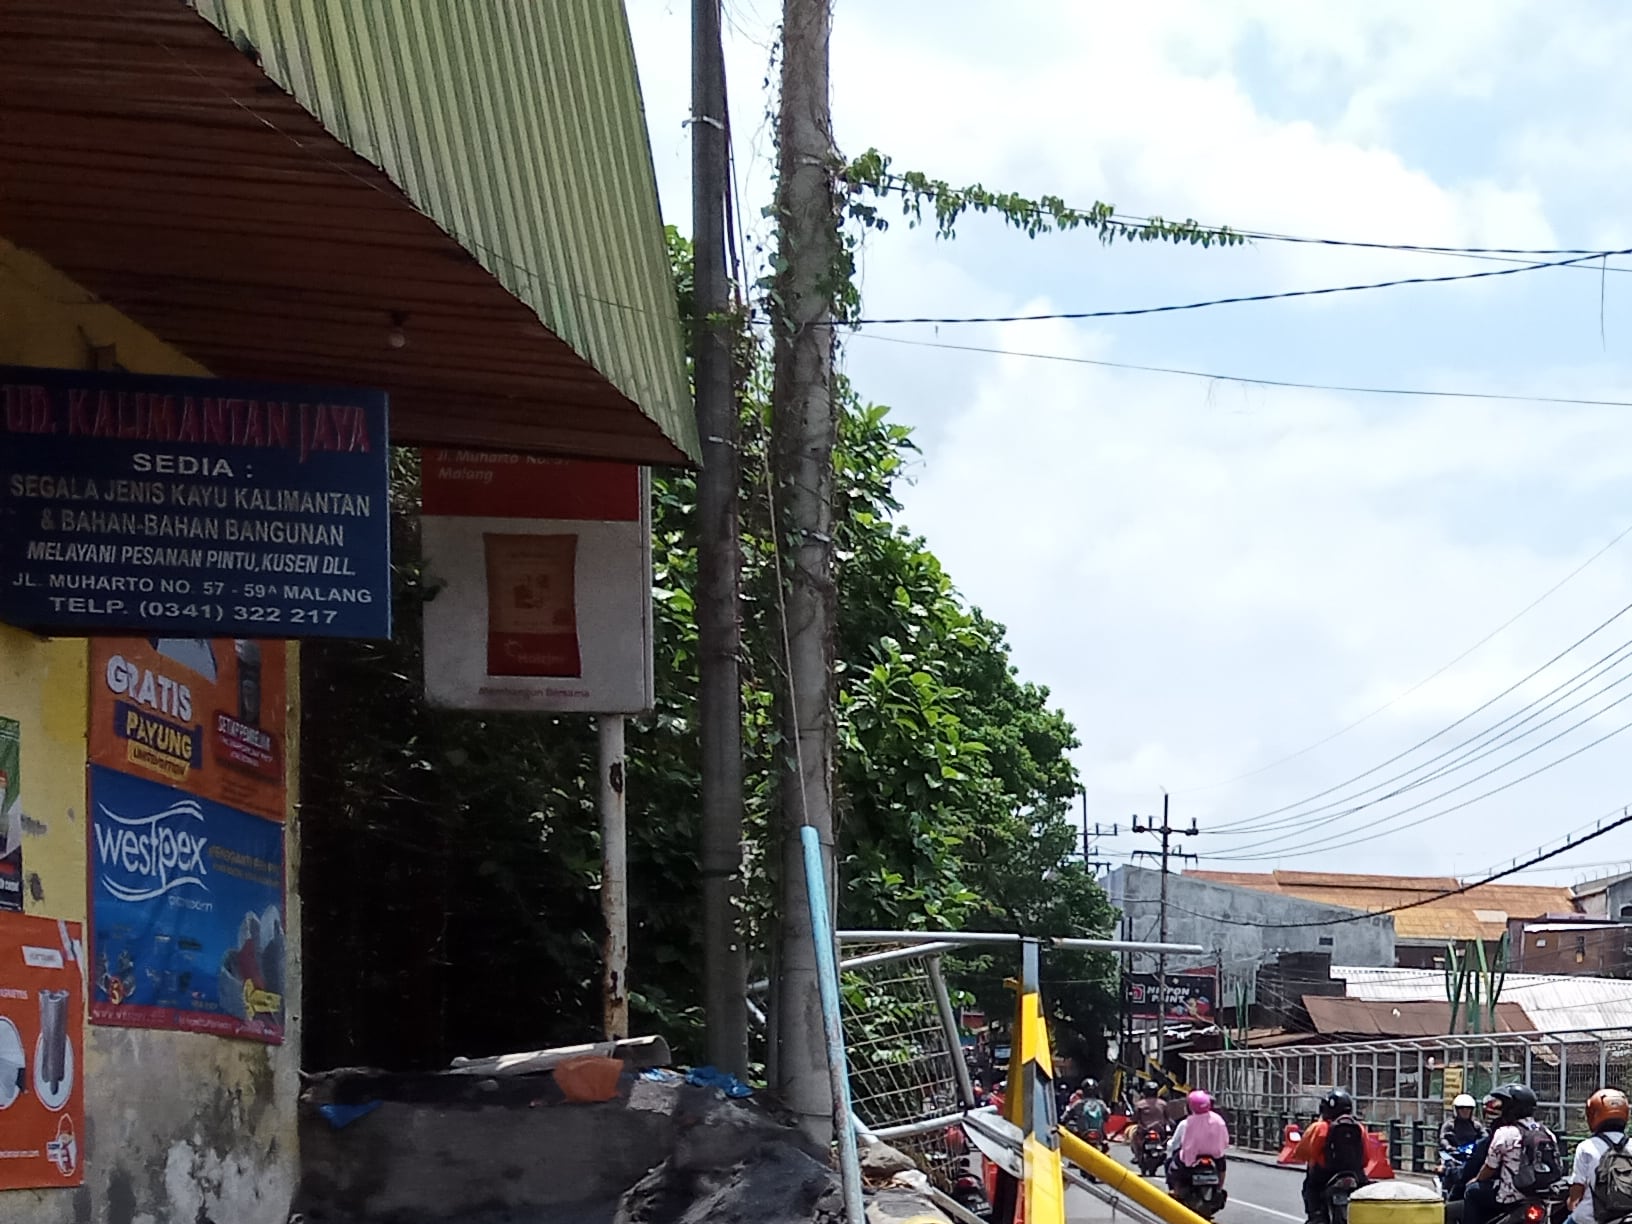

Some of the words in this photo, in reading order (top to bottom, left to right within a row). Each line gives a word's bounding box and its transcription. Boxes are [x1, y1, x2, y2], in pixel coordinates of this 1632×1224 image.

[68, 388, 290, 448] KALIMANTAN
[299, 403, 372, 464] JAYA
[133, 453, 235, 478] SEDIA
[437, 467, 494, 484] Malang
[11, 473, 99, 499] SEGALA
[104, 479, 164, 503] JENIS
[171, 483, 228, 509] KAYU
[234, 487, 371, 517] KALIMANTAN
[41, 508, 54, 531] &
[61, 509, 218, 540] BAHAN-BAHAN
[225, 519, 344, 547] BANGUNAN
[27, 541, 117, 564] MELAYANI
[121, 545, 202, 569] PESANAN
[321, 555, 357, 577] DLL.
[49, 574, 154, 593] MUHARTO
[203, 581, 225, 596] 57
[283, 585, 373, 604] MALANG
[48, 596, 129, 615] TELP.
[139, 600, 224, 623] (0341)
[233, 605, 282, 623] 322
[289, 608, 339, 625] 217
[106, 655, 193, 722] GRATIS
[126, 711, 193, 759] PAYUNG
